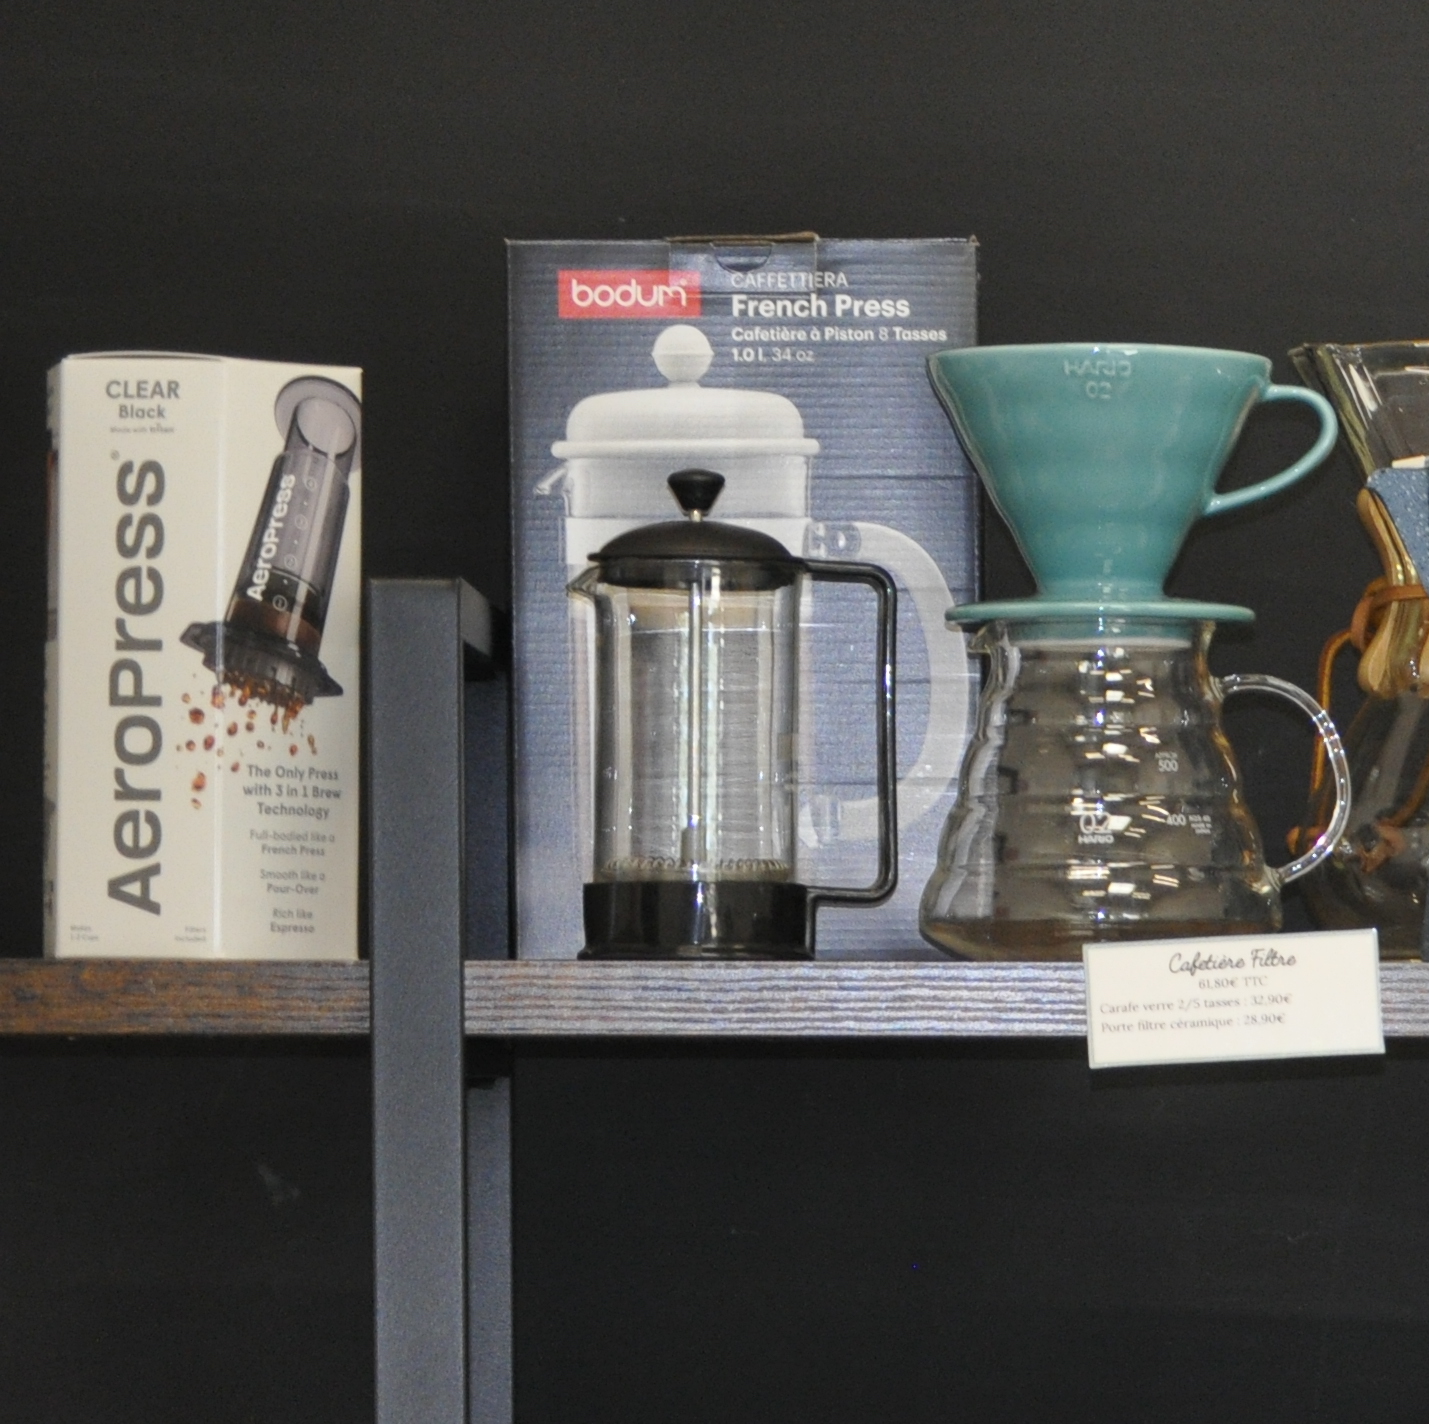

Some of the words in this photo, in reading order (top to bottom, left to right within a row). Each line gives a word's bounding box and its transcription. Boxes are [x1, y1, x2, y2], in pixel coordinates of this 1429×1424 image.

[731, 271, 849, 289] CAFFETTIERA
[571, 277, 688, 307] bodum
[731, 294, 829, 318] French
[835, 295, 911, 318] Press
[731, 326, 808, 343] Cafetière
[810, 326, 822, 342] à
[825, 326, 875, 342] Piston
[878, 329, 889, 342] 8
[894, 326, 948, 342] Tasses
[731, 347, 754, 362] 1.0
[771, 348, 793, 362] 34
[795, 351, 815, 362] oz
[105, 379, 181, 399] CLEAR
[1086, 381, 1112, 399] 02
[118, 403, 166, 419] Black
[246, 472, 297, 602] AeroPress
[107, 456, 167, 916] AeroPress
[247, 765, 271, 779] The
[275, 765, 305, 781] Only
[308, 767, 339, 780] Press
[1158, 760, 1179, 772] 500
[243, 784, 272, 797] with
[276, 785, 284, 797] 3
[286, 785, 298, 798] in
[302, 786, 308, 798] 1
[311, 786, 342, 799] Brew
[257, 802, 330, 820] Technology
[261, 844, 297, 856] French
[300, 845, 325, 857] Press
[1169, 951, 1246, 975] Cafetière
[1251, 948, 1297, 969] Filtre
[1244, 976, 1268, 987] TTC
[1100, 1001, 1140, 1014] Carafe
[1142, 1001, 1174, 1012] verre
[1204, 997, 1240, 1009] tasses
[1102, 1020, 1134, 1033] Porte
[1137, 1018, 1166, 1031] filtre
[1170, 1016, 1233, 1031] céramique
